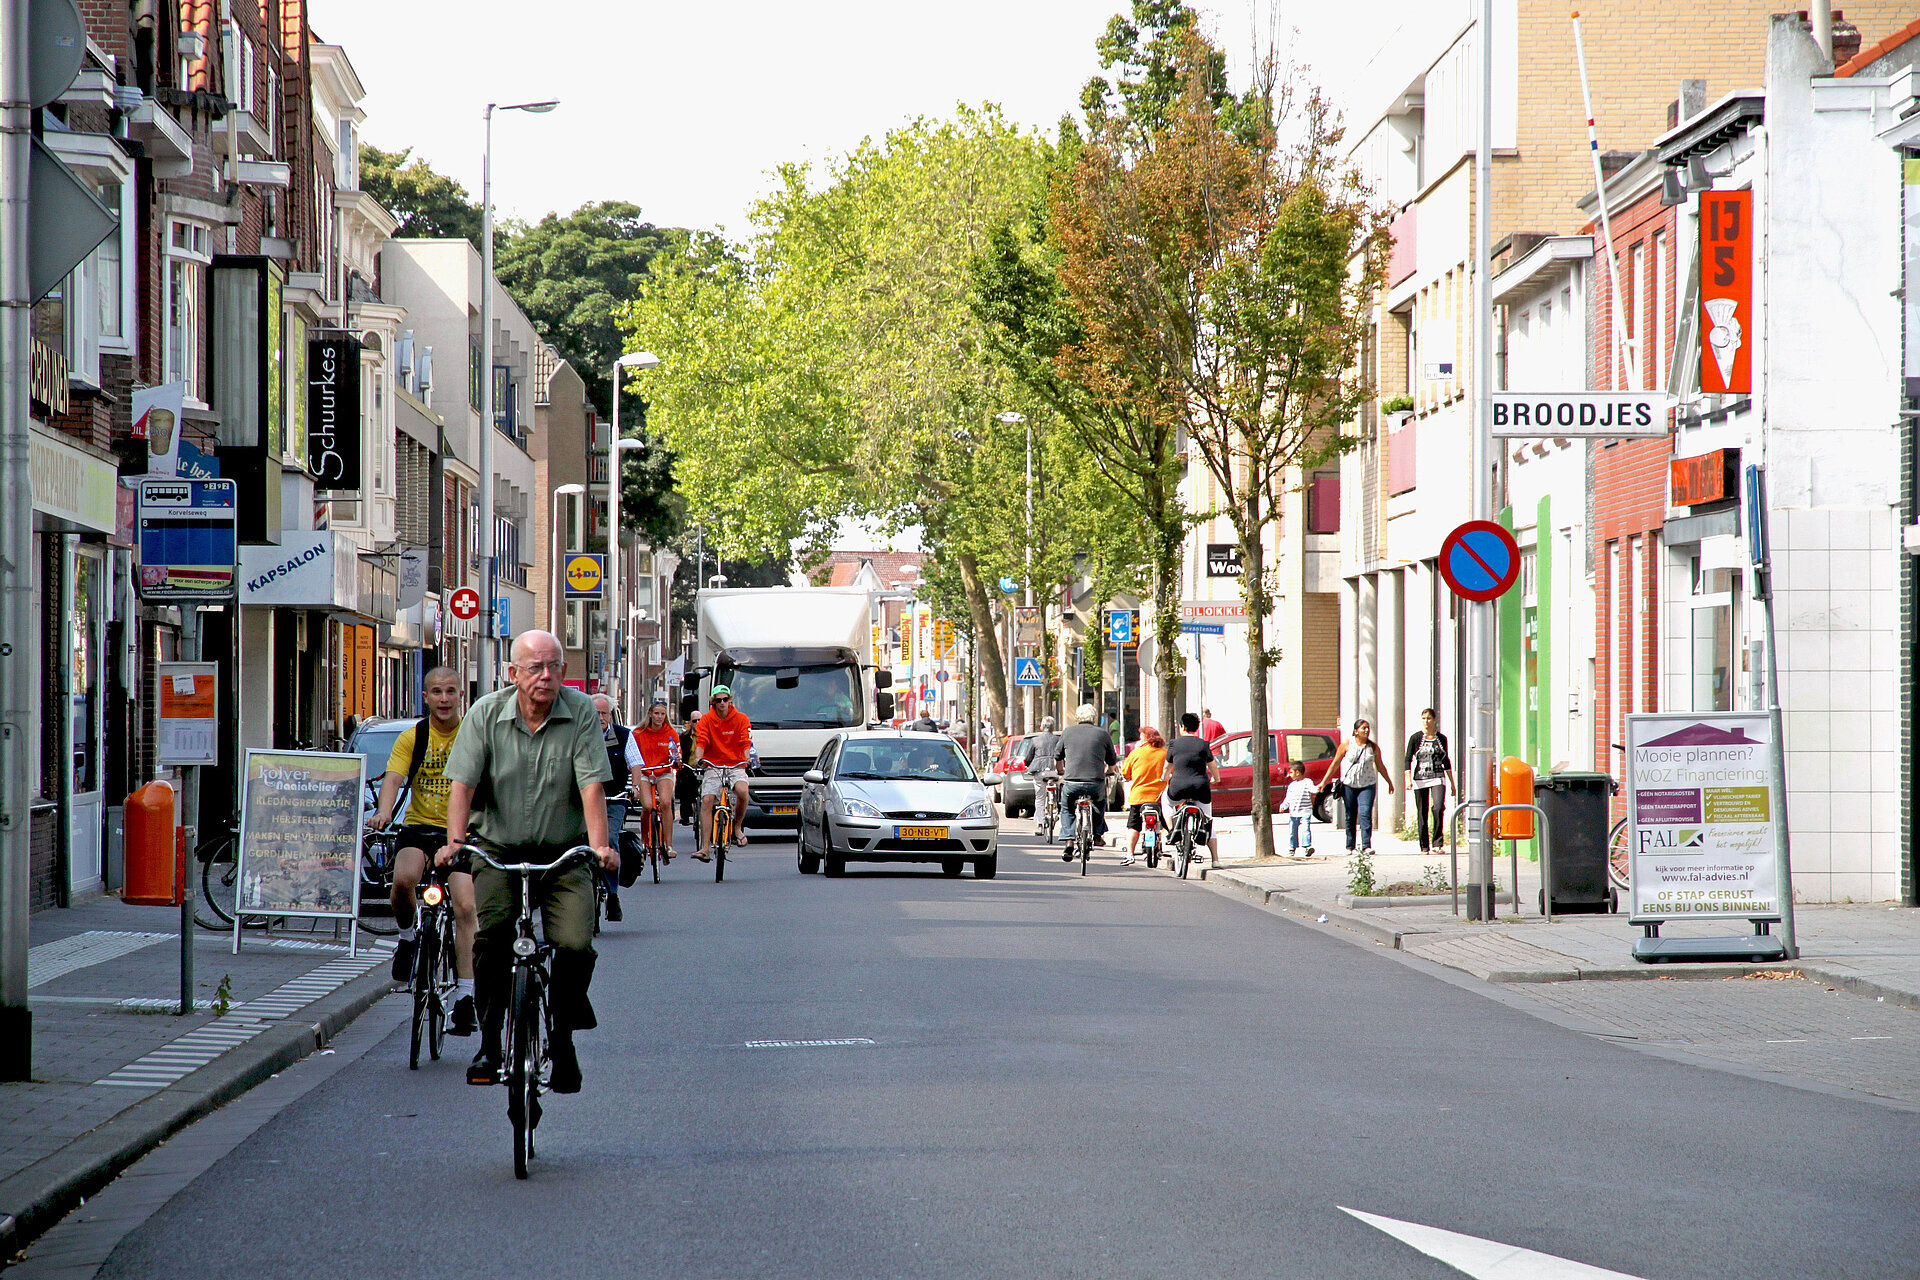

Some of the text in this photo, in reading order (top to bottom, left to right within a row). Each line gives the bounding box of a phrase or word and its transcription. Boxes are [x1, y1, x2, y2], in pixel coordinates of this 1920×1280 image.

[31, 336, 69, 416] ORDIJNEN
[309, 347, 344, 481] Schuurkes
[1493, 402, 1651, 426] BROODJES
[168, 509, 207, 517] Korvelseweg
[142, 519, 148, 527] 8
[247, 543, 326, 592] KAPSALON
[1210, 561, 1245, 574] WON
[1184, 606, 1247, 617] BLOKKE
[901, 618, 912, 661] Nettorama
[1636, 747, 1754, 764] Mooie plannen?
[1636, 767, 1769, 783] WOZ Financiering:
[256, 796, 350, 808] KLEDINGREPARATIE
[271, 814, 332, 825] HERSTELLEN
[246, 831, 356, 843] MAKEN EN VERMAKEN
[902, 828, 945, 836] 30-NB-VT
[1638, 829, 1677, 853] FAL
[248, 848, 307, 859] GORDIJNEN
[1706, 864, 1744, 872] informatie
[1745, 865, 1754, 873] op
[1662, 872, 1748, 882] www.fal-advies.nl
[1658, 890, 1754, 900] OF STAP GERUST
[1643, 901, 1770, 913] EENS BIJ ONS BINNEN!
